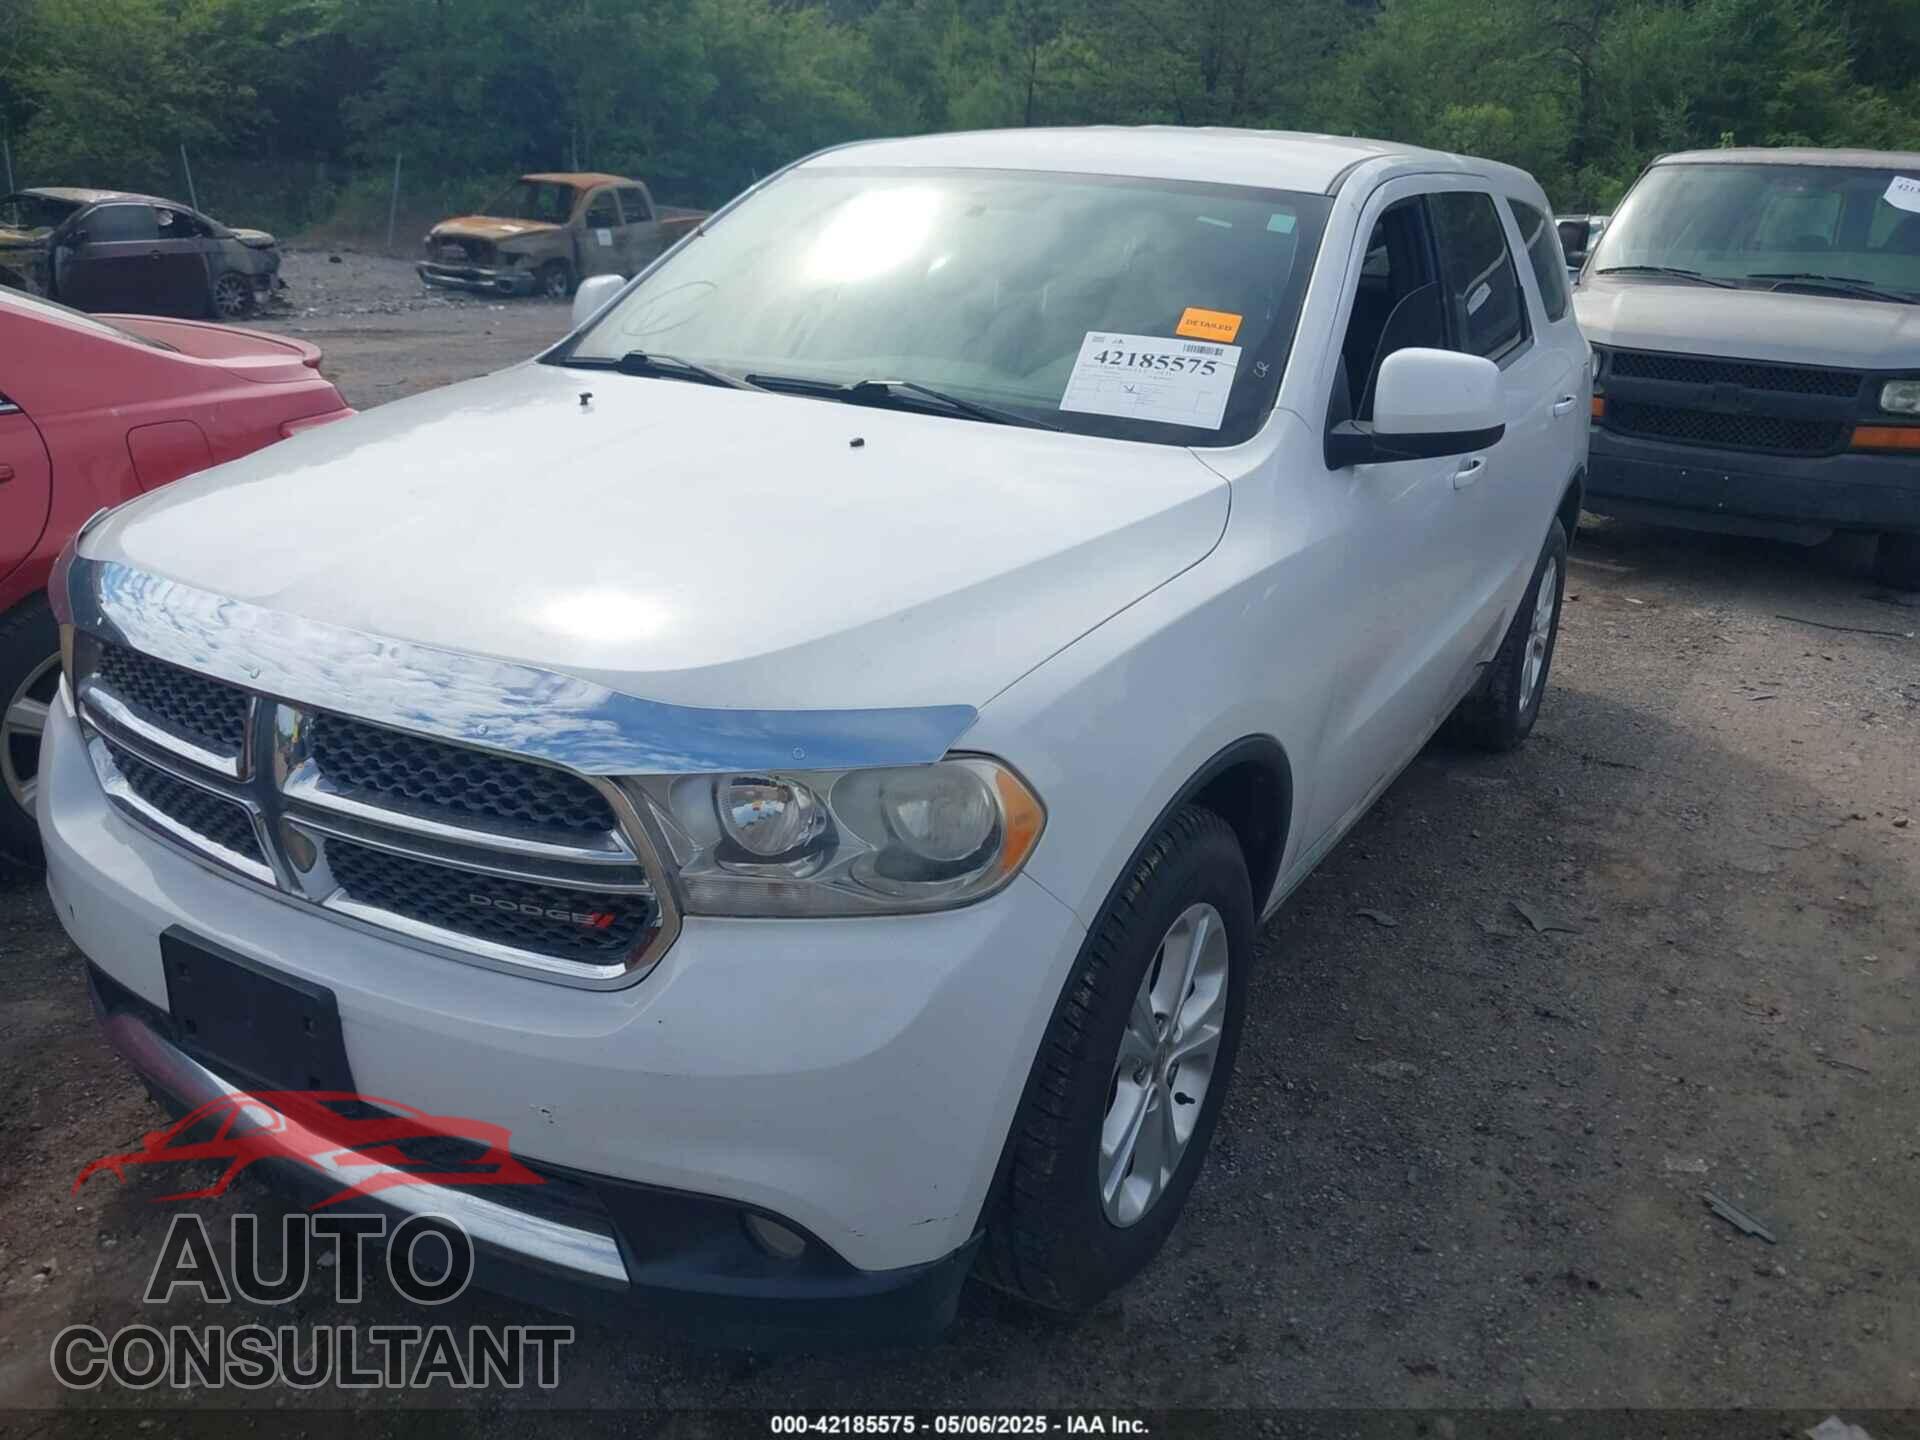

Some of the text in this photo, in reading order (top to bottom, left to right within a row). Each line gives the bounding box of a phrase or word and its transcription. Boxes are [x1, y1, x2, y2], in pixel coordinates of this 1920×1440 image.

[1185, 319, 1233, 331] DETAILED
[1094, 350, 1218, 376] 42185575
[470, 894, 594, 925] DODGE
